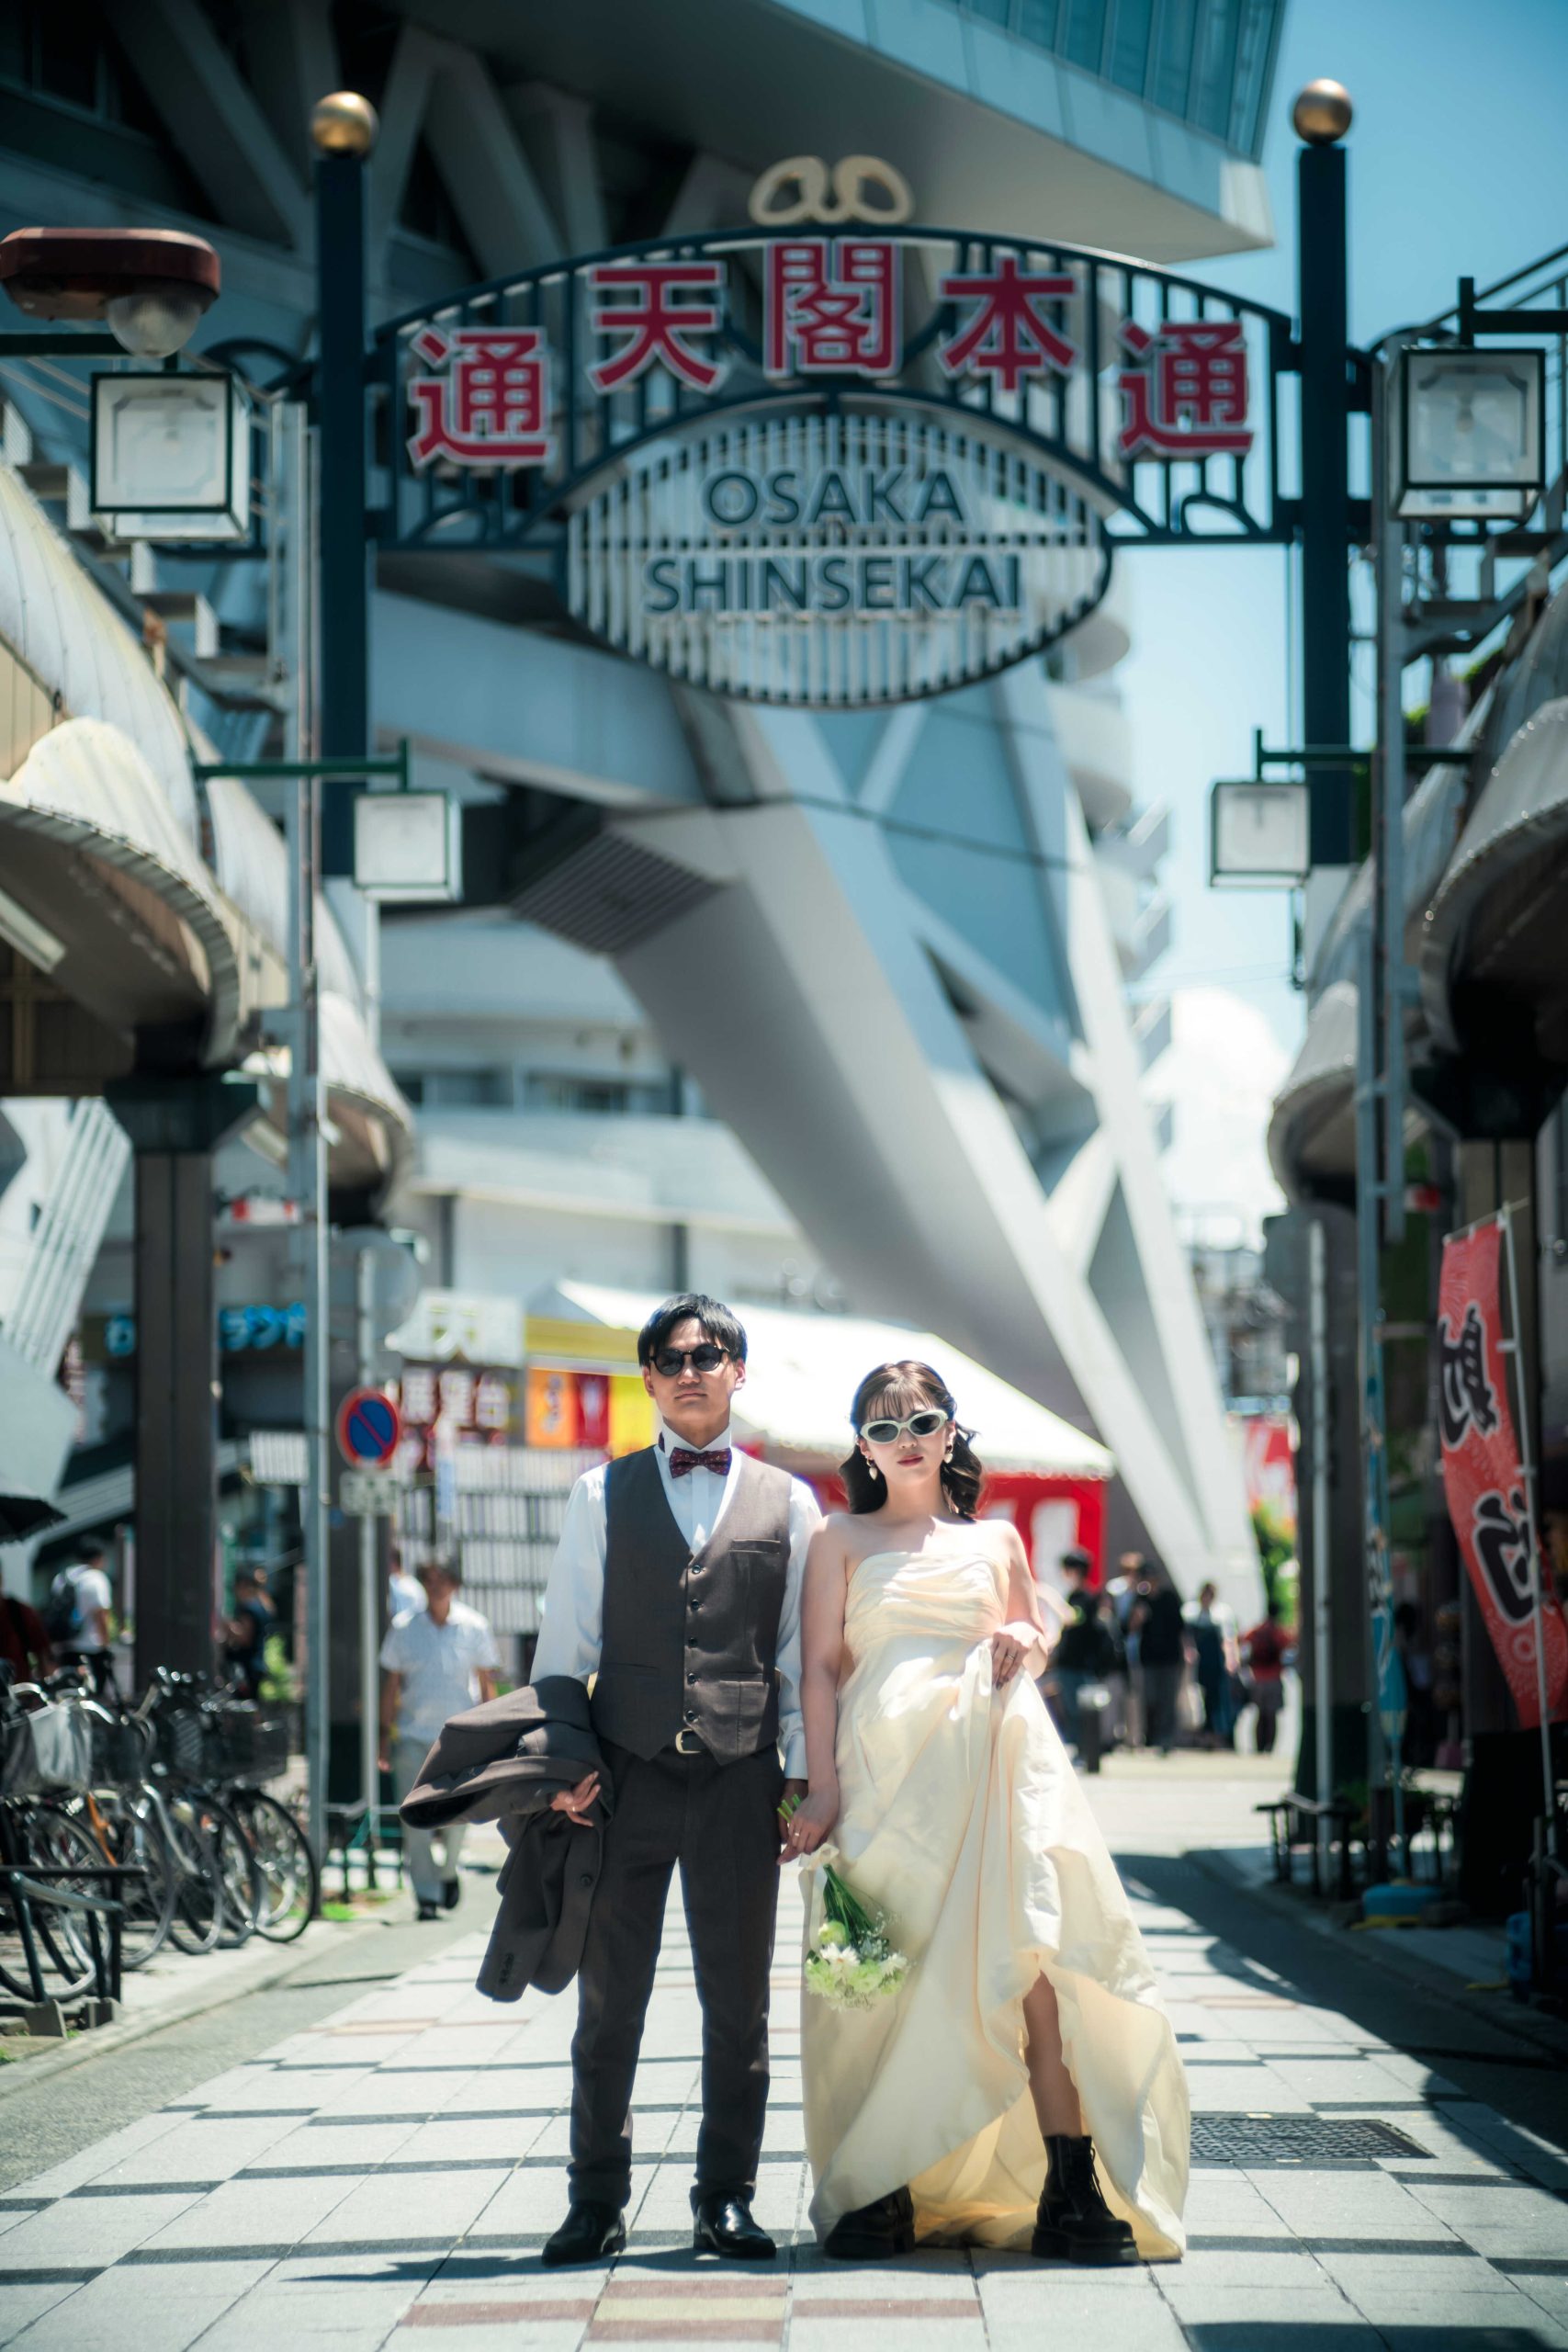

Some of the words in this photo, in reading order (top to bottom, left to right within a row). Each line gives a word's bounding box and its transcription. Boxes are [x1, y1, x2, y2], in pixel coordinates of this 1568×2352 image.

[407, 238, 1255, 467] 通天閣本通
[702, 469, 964, 527] OSAKA
[645, 554, 1021, 614] SHINSEKAI
